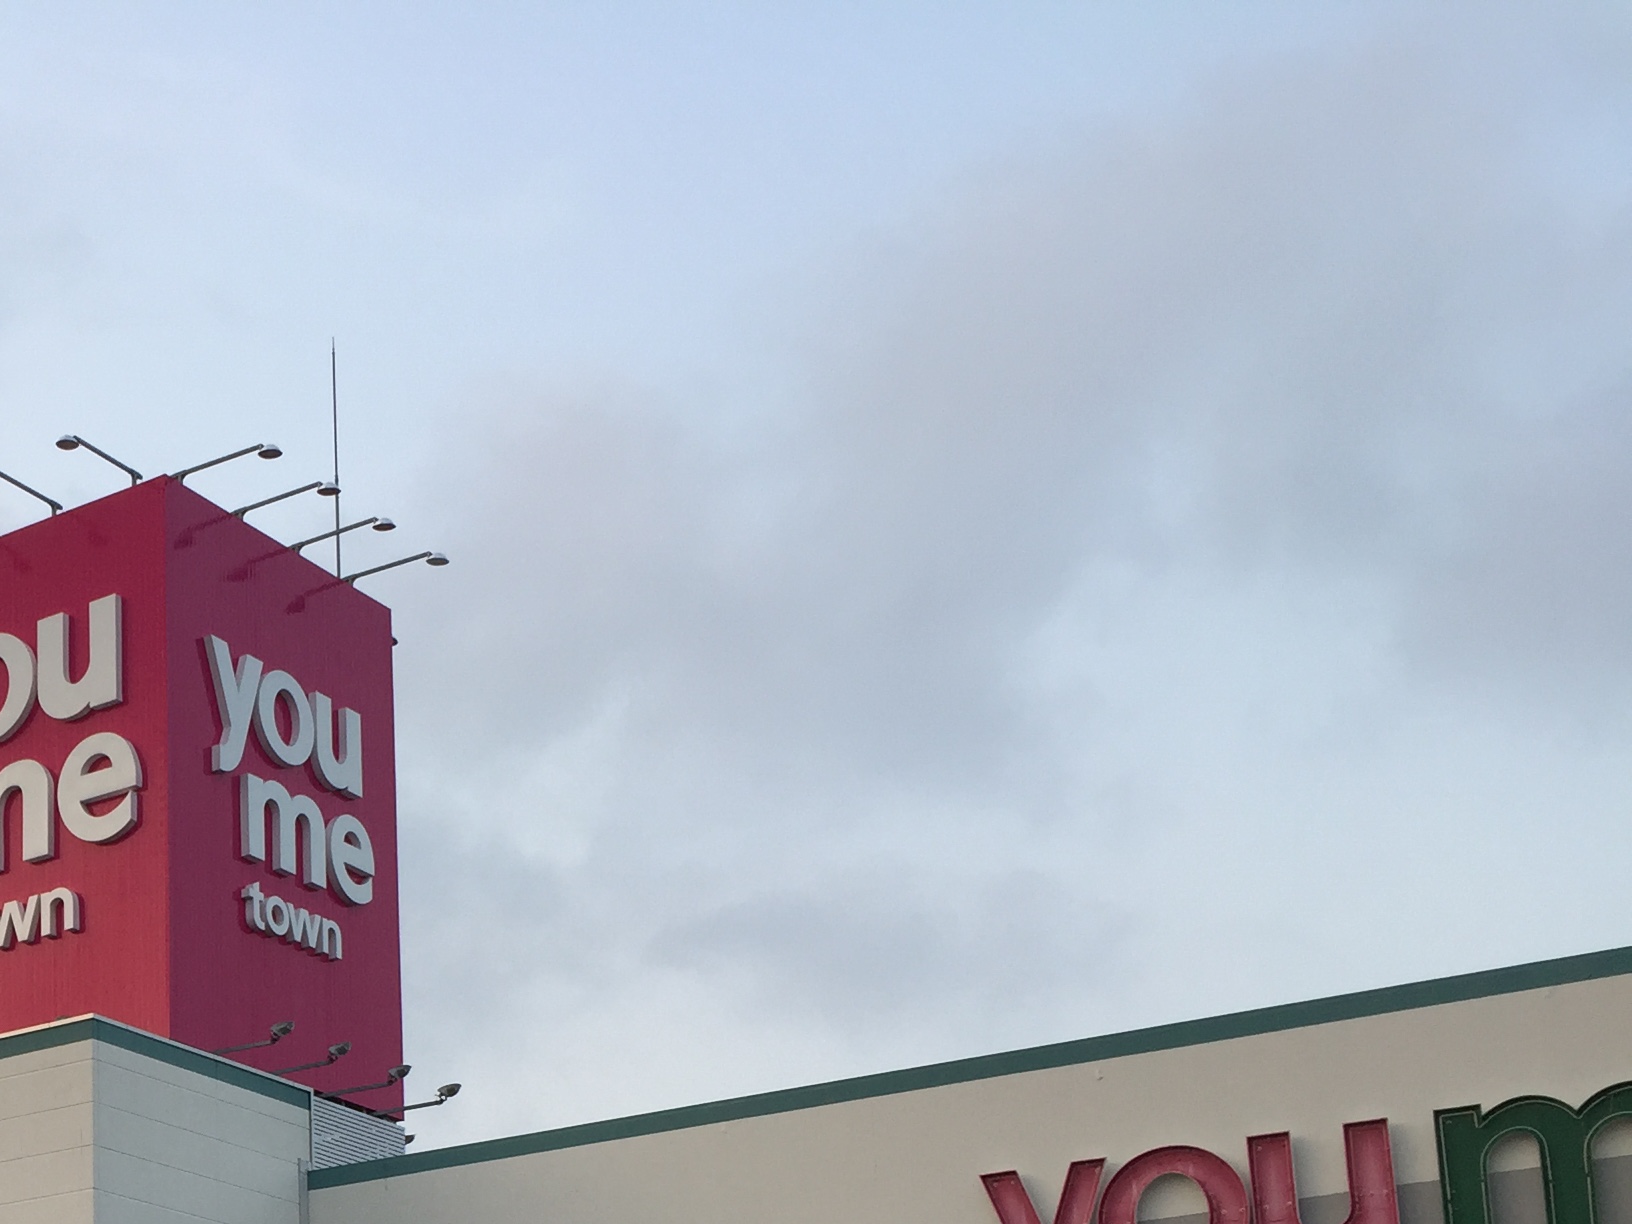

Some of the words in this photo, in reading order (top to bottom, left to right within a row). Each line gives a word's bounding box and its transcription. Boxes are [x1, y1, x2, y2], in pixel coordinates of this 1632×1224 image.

[204, 634, 363, 798] you
[240, 772, 375, 905] me
[240, 881, 343, 961] town
